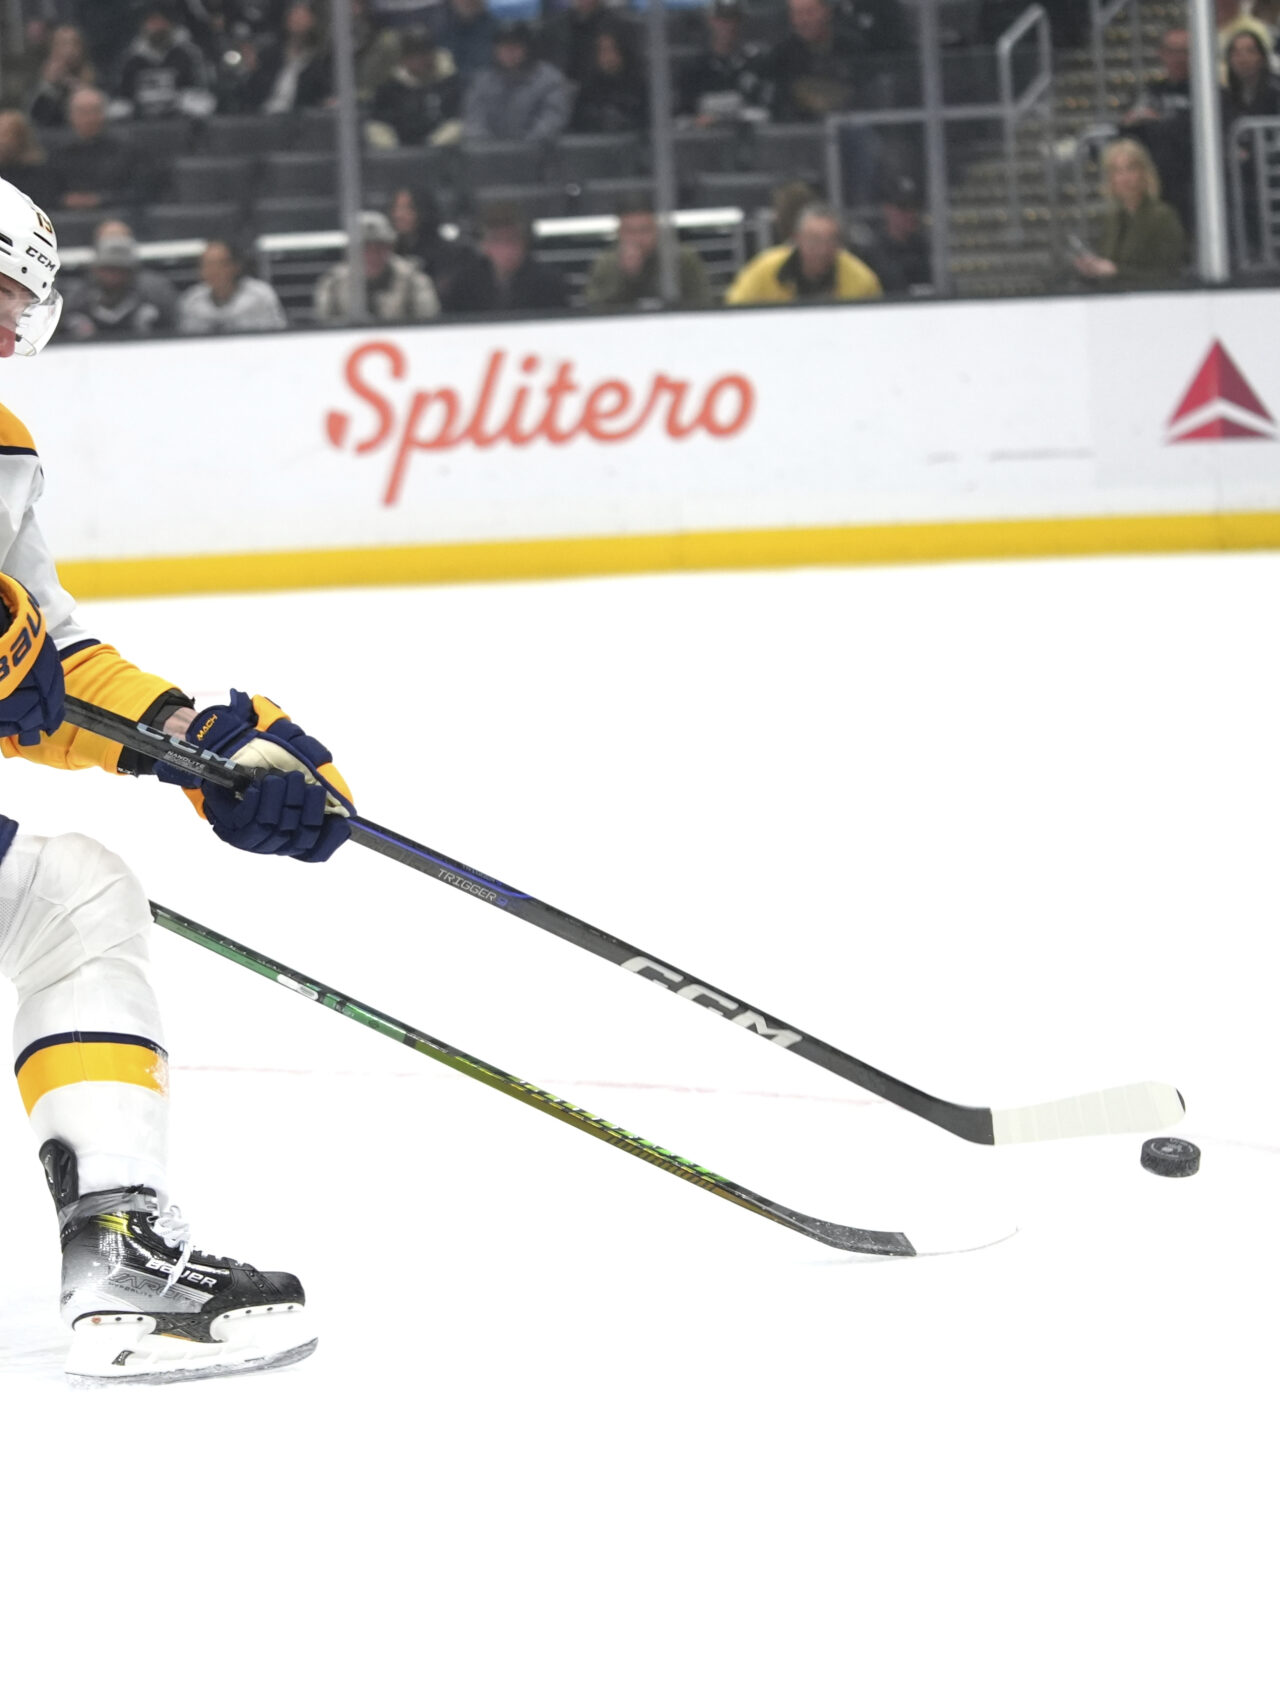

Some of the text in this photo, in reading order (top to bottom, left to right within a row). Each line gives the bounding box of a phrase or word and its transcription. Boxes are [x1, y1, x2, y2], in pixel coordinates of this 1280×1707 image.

[25, 246, 56, 271] CCM
[326, 340, 757, 509] Splitero
[136, 722, 237, 770] CCM
[196, 713, 219, 742] MACH
[437, 868, 497, 902] TRIGGER
[620, 955, 804, 1049] CCM
